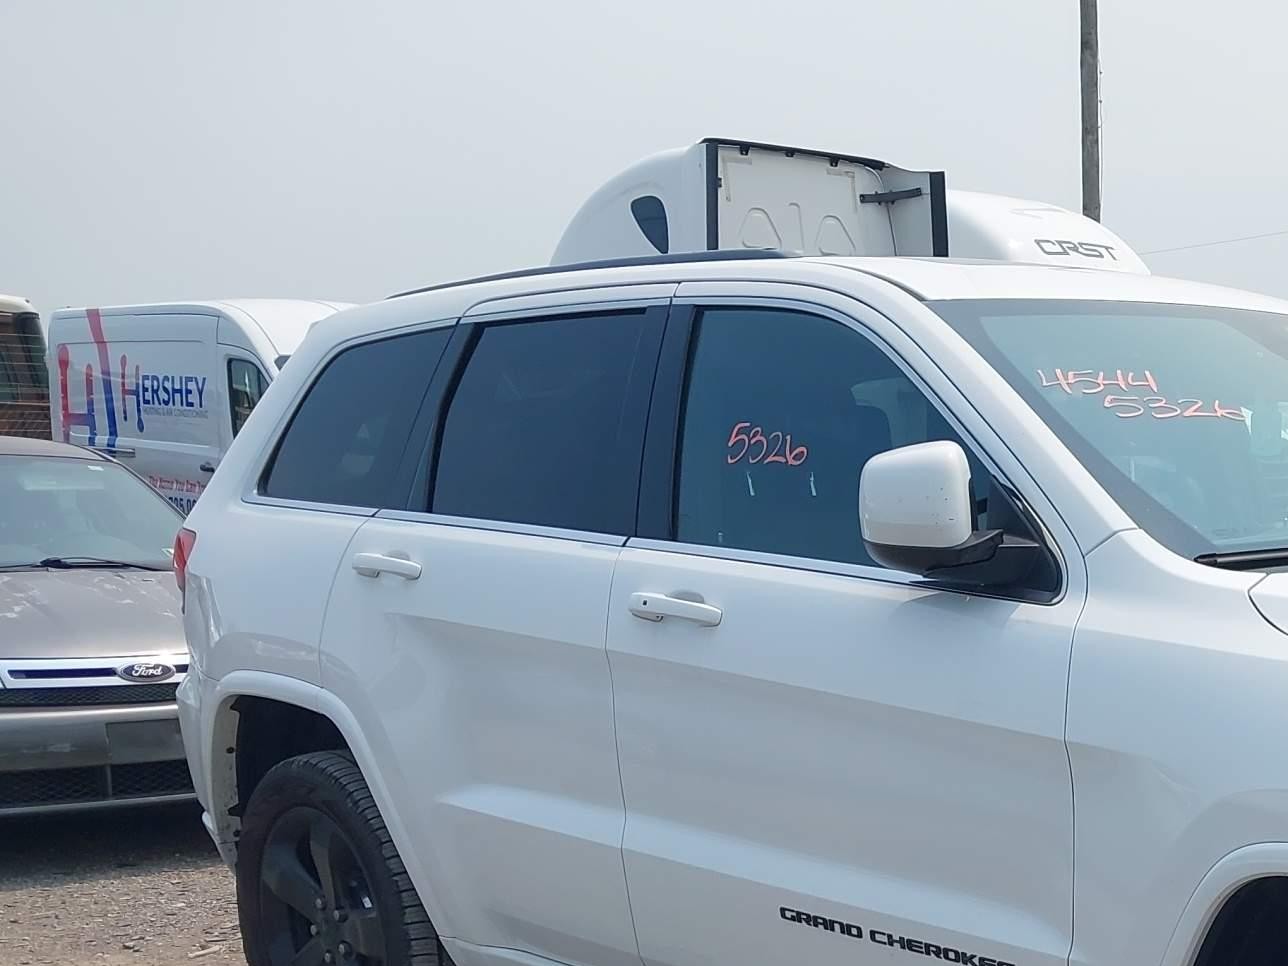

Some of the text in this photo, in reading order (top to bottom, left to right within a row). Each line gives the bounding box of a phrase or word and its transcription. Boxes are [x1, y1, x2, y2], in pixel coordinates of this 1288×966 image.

[1033, 239, 1117, 261] CRST
[120, 354, 207, 433] HERSHEY
[1037, 368, 1158, 394] 4544
[1103, 395, 1248, 421] 5326
[728, 422, 808, 465] 5326
[132, 664, 162, 676] Ford
[780, 907, 863, 939] GRAND
